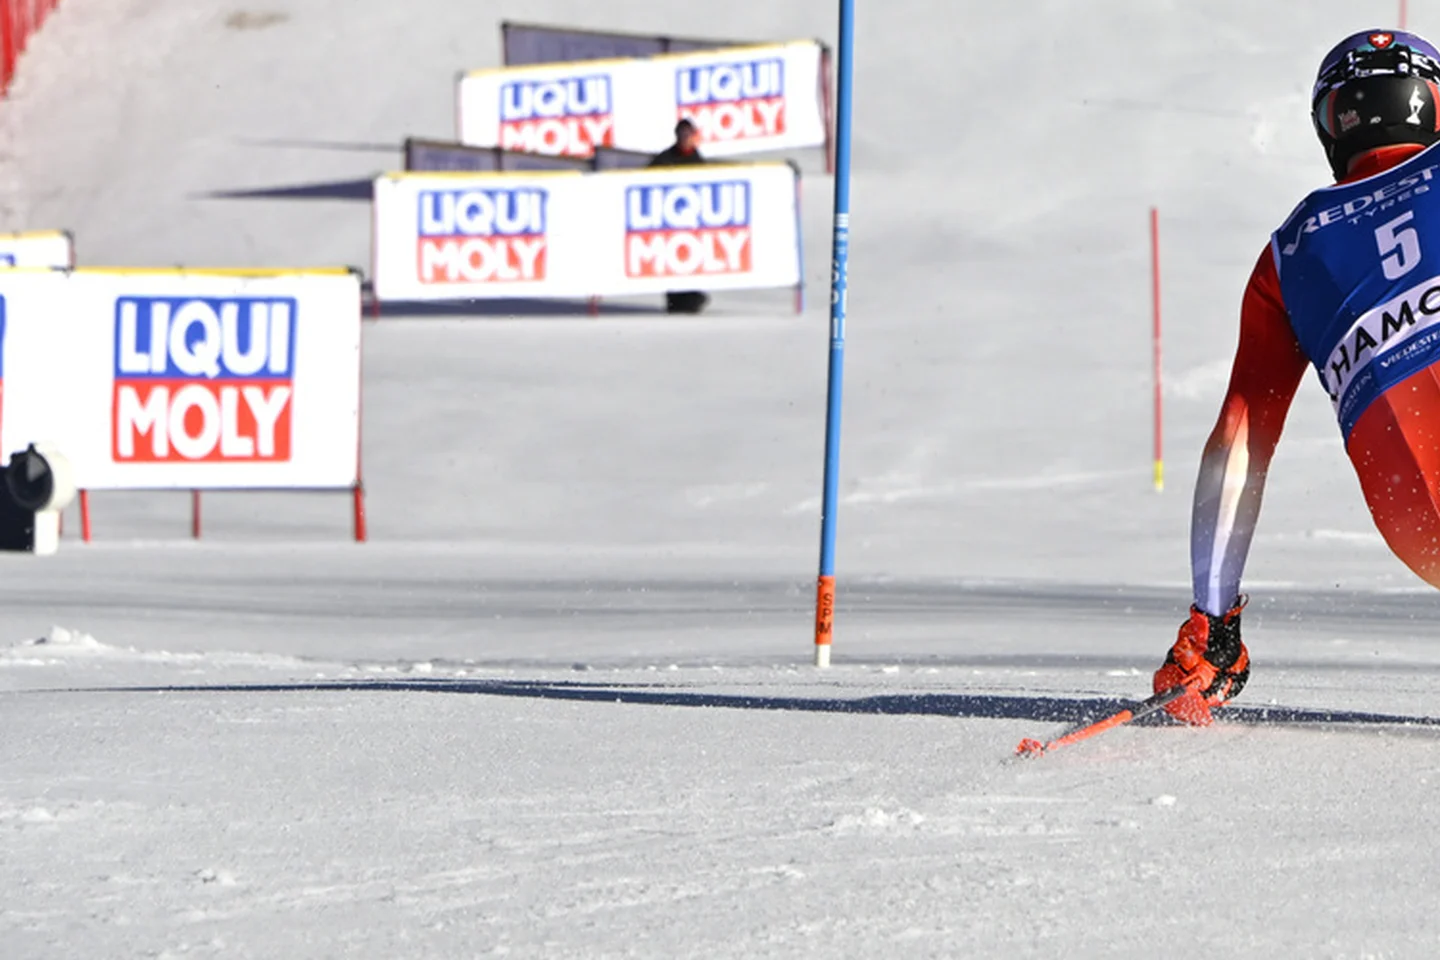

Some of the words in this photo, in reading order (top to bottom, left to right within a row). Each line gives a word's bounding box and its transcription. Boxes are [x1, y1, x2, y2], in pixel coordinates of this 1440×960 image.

[503, 77, 608, 121] LIQUI
[679, 61, 782, 104] LIQUI
[421, 191, 544, 237] LIQUI
[628, 184, 748, 231] LIQUI
[1348, 185, 1430, 226] TYRES
[420, 238, 545, 283] MOLY
[628, 230, 750, 278] MOLY
[1375, 210, 1422, 281] 5
[119, 301, 290, 378] LIQUI
[116, 384, 292, 460] MOLY
